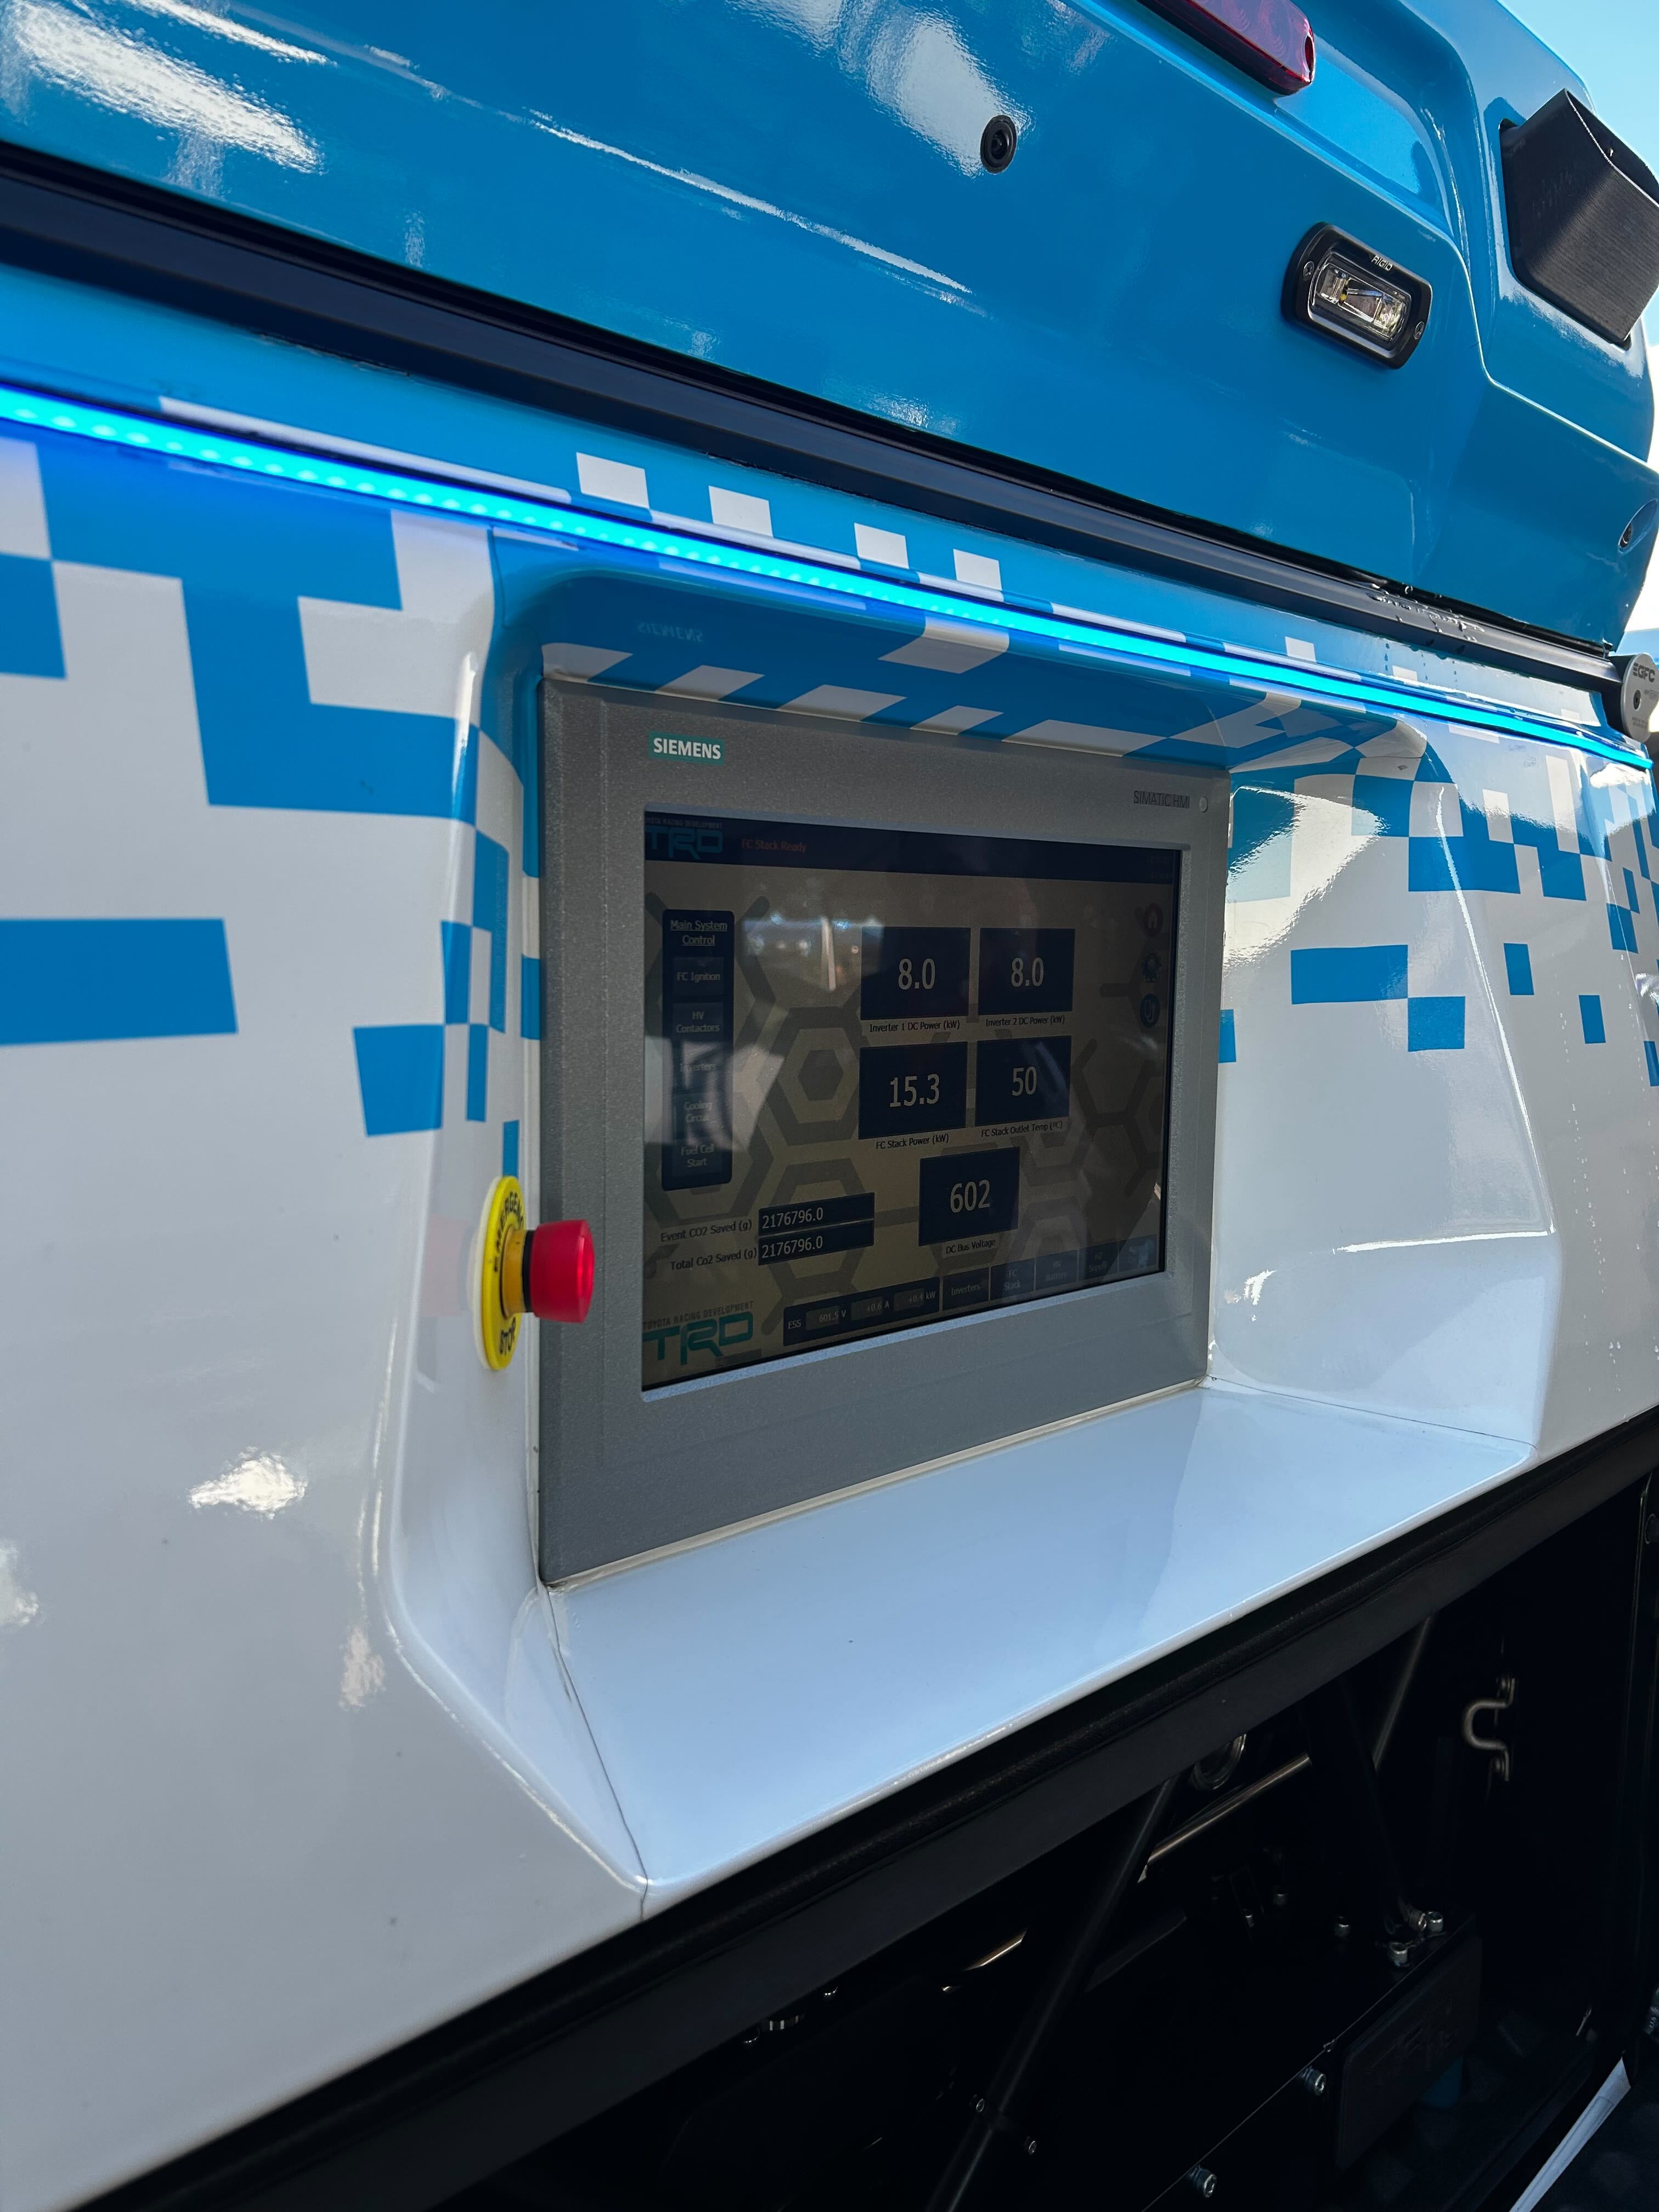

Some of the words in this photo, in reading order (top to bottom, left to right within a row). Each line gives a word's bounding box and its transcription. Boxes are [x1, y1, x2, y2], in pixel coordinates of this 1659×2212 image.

[1371, 255, 1393, 271] RIGID
[653, 737, 721, 760] SIEMENS
[1133, 790, 1173, 806] SIMATIC
[1173, 794, 1190, 809] HMI
[645, 825, 724, 861] TRD
[742, 839, 754, 849] FC
[755, 839, 781, 850] Stack
[781, 841, 808, 855] Ready
[670, 920, 693, 932] Main
[695, 921, 728, 932] System
[682, 935, 715, 946] Control
[676, 972, 689, 981] FC
[690, 972, 721, 983] Ignition
[898, 958, 936, 990] 8.0
[1011, 957, 1045, 987] 8.0
[692, 1011, 705, 1020] HV
[986, 1018, 1011, 1026] Inverter
[1050, 1014, 1065, 1025] (kW)
[676, 1024, 720, 1033] Contactors
[870, 1023, 898, 1032] Inverter
[908, 1022, 919, 1031] DC
[920, 1021, 940, 1030] Power
[944, 1019, 960, 1030] (kW)
[1012, 1065, 1037, 1097] 50
[888, 1073, 940, 1108] 15.3
[981, 1130, 990, 1138] FC
[991, 1126, 1008, 1136] Stack
[1010, 1125, 1029, 1135] Outlet
[1031, 1124, 1048, 1133] Temp
[681, 1146, 698, 1156] Fuel
[699, 1143, 715, 1154] Cell
[876, 1141, 887, 1150] FC
[888, 1139, 907, 1149] Stack
[909, 1137, 930, 1147] Power
[932, 1133, 949, 1146] (kW)
[686, 1157, 707, 1167] Start
[950, 1180, 990, 1213] 602
[661, 1230, 686, 1243] Event
[689, 1226, 707, 1238] CO2
[710, 1221, 736, 1234] Saved
[739, 1219, 752, 1232] (g)
[761, 1207, 823, 1229] 2176796.0
[669, 1257, 693, 1271] Total
[696, 1255, 713, 1266] Co2
[715, 1251, 741, 1262] Saved
[744, 1247, 757, 1260] (g)
[761, 1235, 823, 1259] 2176796.0
[946, 1245, 956, 1254] DC
[957, 1244, 970, 1252] Bus
[971, 1239, 996, 1250] Voltage
[1008, 1268, 1018, 1278] FC
[951, 1284, 981, 1296] Inverters
[1004, 1280, 1021, 1291] Stack
[642, 1318, 670, 1331] TOYOTA
[674, 1311, 701, 1323] RACING
[703, 1301, 755, 1318] DEVELOPMENT
[788, 1319, 802, 1329] ESS
[841, 1310, 847, 1318] V
[884, 1300, 890, 1308] A
[926, 1290, 936, 1300] kW
[642, 1311, 754, 1366] TRD
